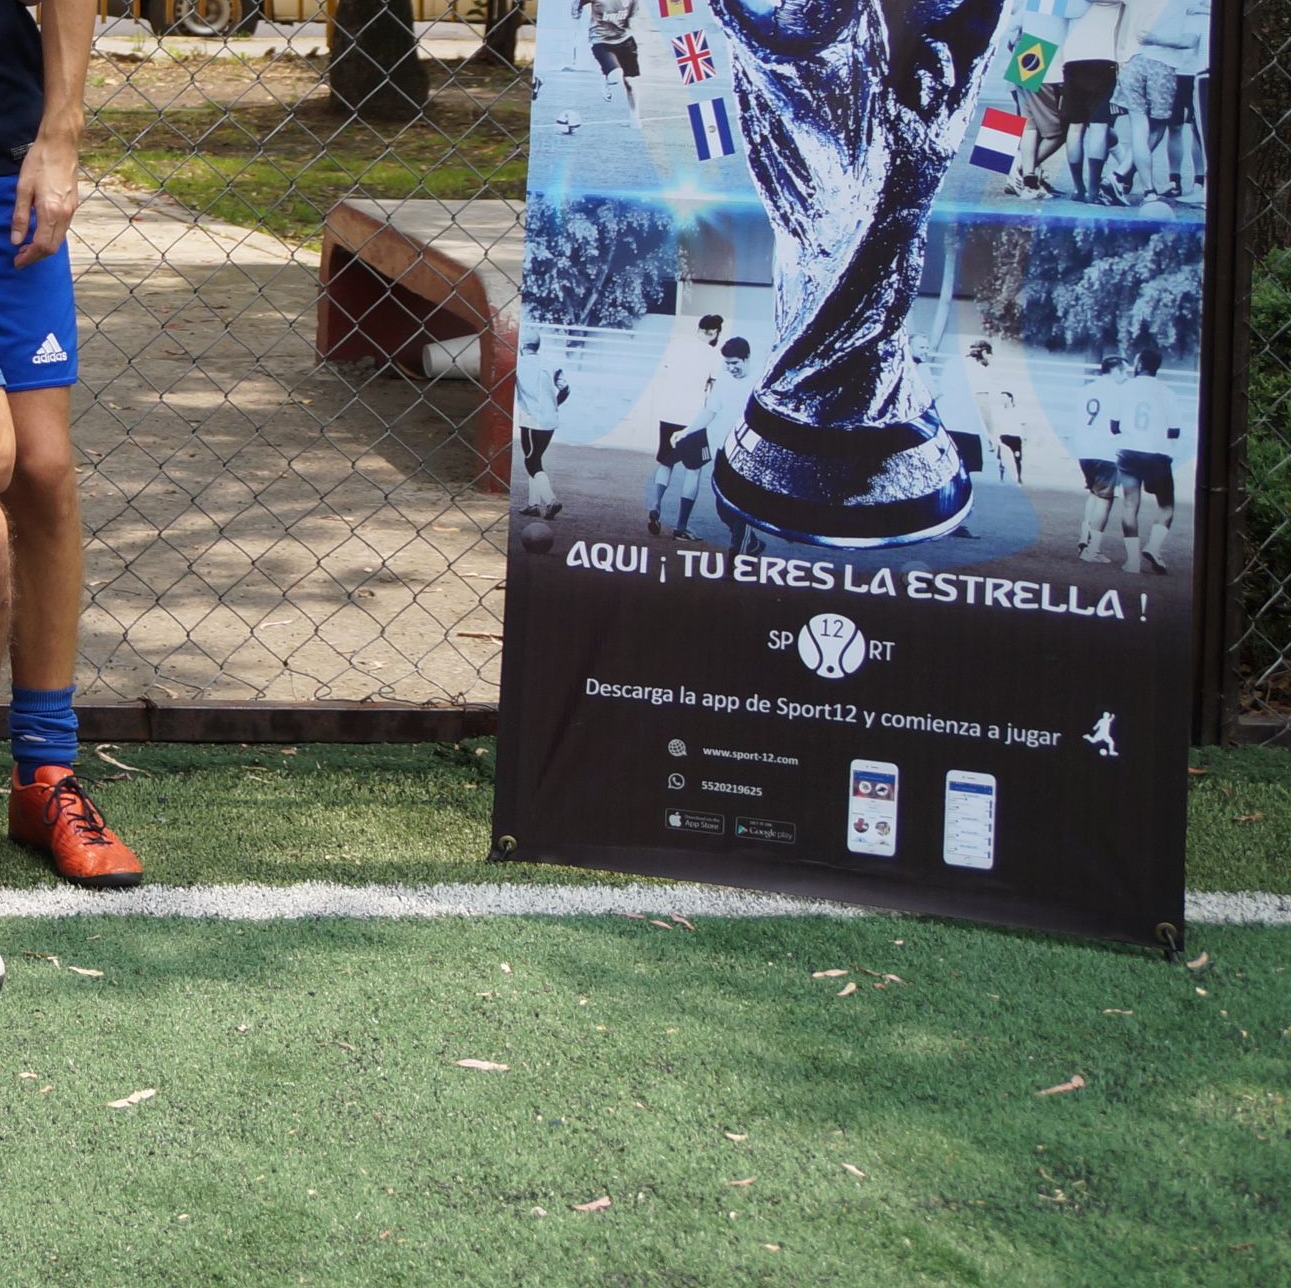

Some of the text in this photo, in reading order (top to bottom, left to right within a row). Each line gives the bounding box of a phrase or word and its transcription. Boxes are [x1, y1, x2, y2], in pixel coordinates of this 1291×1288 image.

[32, 351, 68, 365] adidas
[1086, 398, 1101, 425] 9
[566, 540, 648, 573] AQUI
[677, 549, 725, 579] TU
[733, 554, 835, 590] ERES
[844, 564, 896, 596] LA
[907, 570, 1125, 619] ESTRELLA
[820, 618, 844, 639] 12
[767, 629, 896, 661] SP RT
[585, 678, 1062, 748] Descarga la app de Sport12 y comienza a jugar
[702, 746, 799, 765] www.sport-12.com
[701, 780, 763, 797] 5520219625
